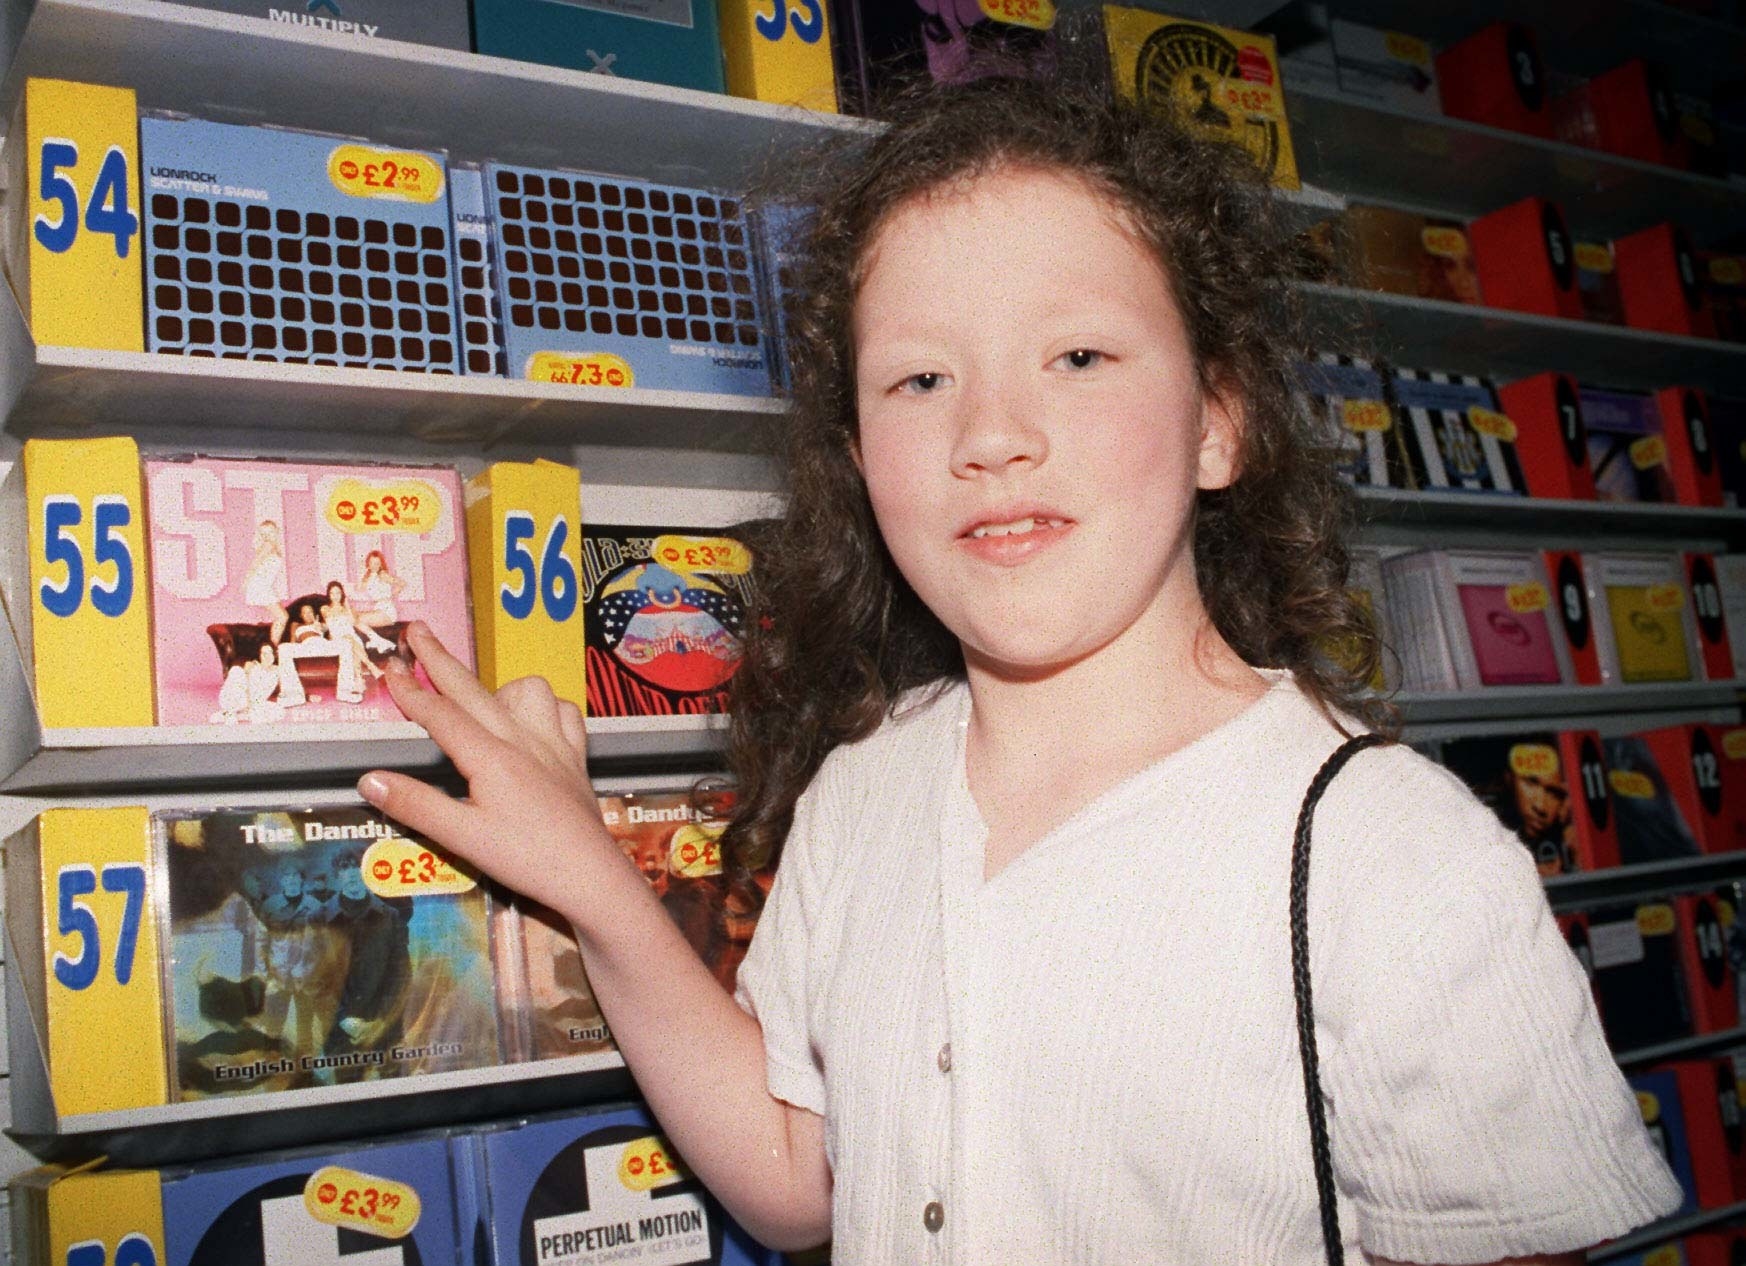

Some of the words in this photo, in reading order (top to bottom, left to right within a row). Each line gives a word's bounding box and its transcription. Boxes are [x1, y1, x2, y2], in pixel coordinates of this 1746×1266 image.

[32, 136, 138, 259] 54
[150, 166, 217, 183] LIONROCK
[39, 493, 134, 618] 55
[500, 510, 578, 622] 56
[1582, 762, 1607, 800] 11
[240, 824, 295, 845] The
[52, 861, 146, 991] 57
[215, 1058, 295, 1082] English
[302, 1049, 385, 1071] Country
[391, 1042, 463, 1061] Garden
[540, 1223, 635, 1260] PERPETUAL
[639, 1209, 703, 1240] MOTION
